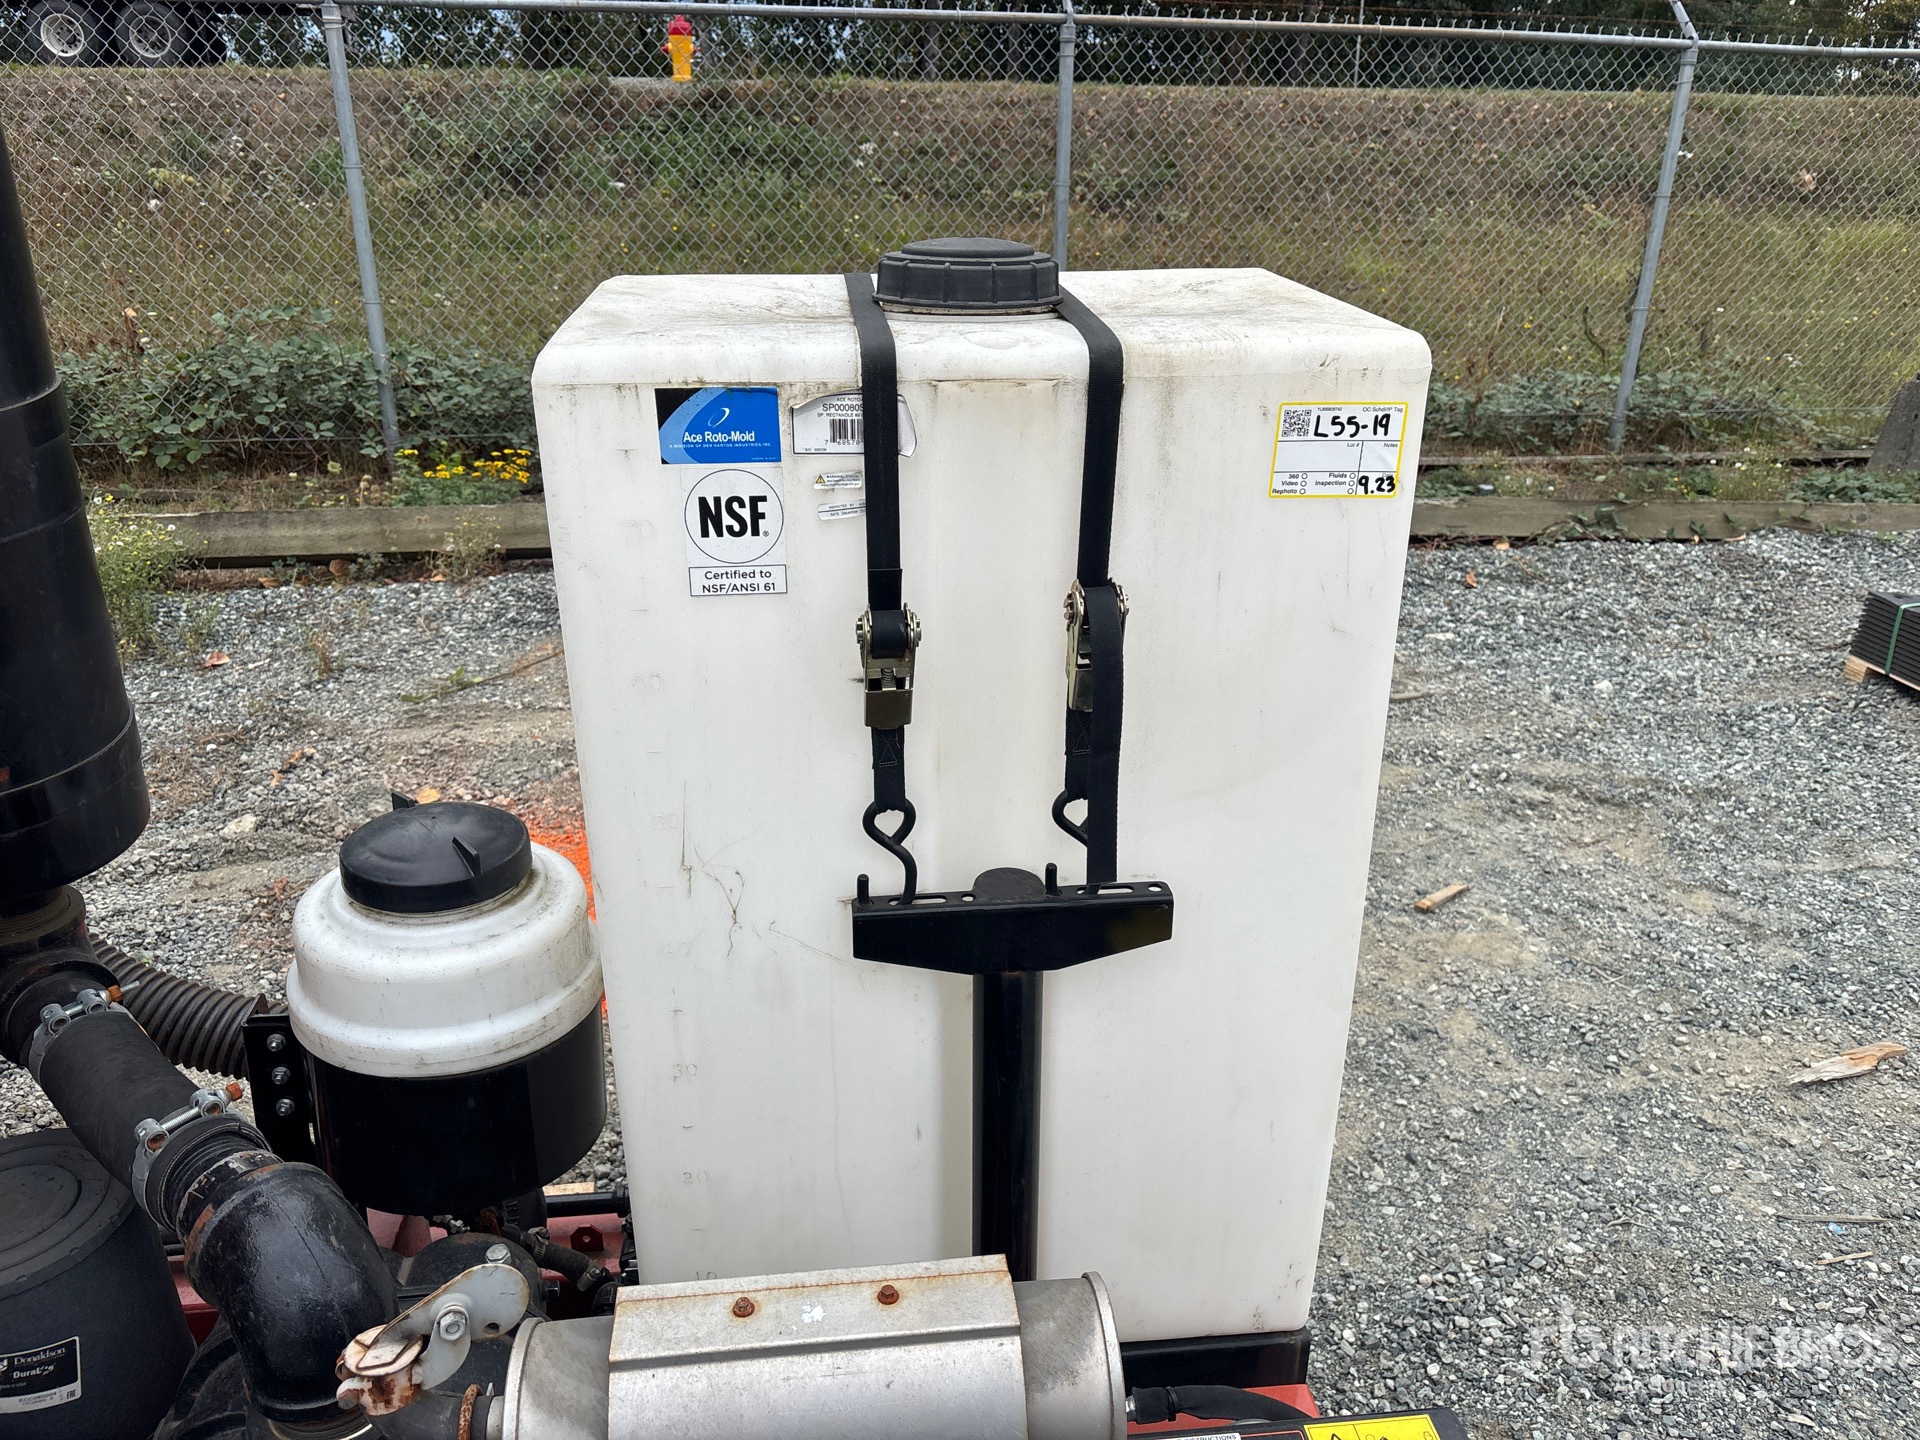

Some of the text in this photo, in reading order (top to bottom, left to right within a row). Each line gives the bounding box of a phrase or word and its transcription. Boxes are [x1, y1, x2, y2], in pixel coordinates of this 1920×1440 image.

[1314, 413, 1391, 438] L55-19
[684, 430, 755, 442] Ace Roto-Mold
[1358, 475, 1396, 495] 9.23
[704, 569, 772, 580] Certified to
[702, 582, 776, 594] NSF/ANSI 61
[672, 1063, 698, 1080] 30
[682, 1170, 708, 1185] 20
[14, 1347, 66, 1366] Donaldson
